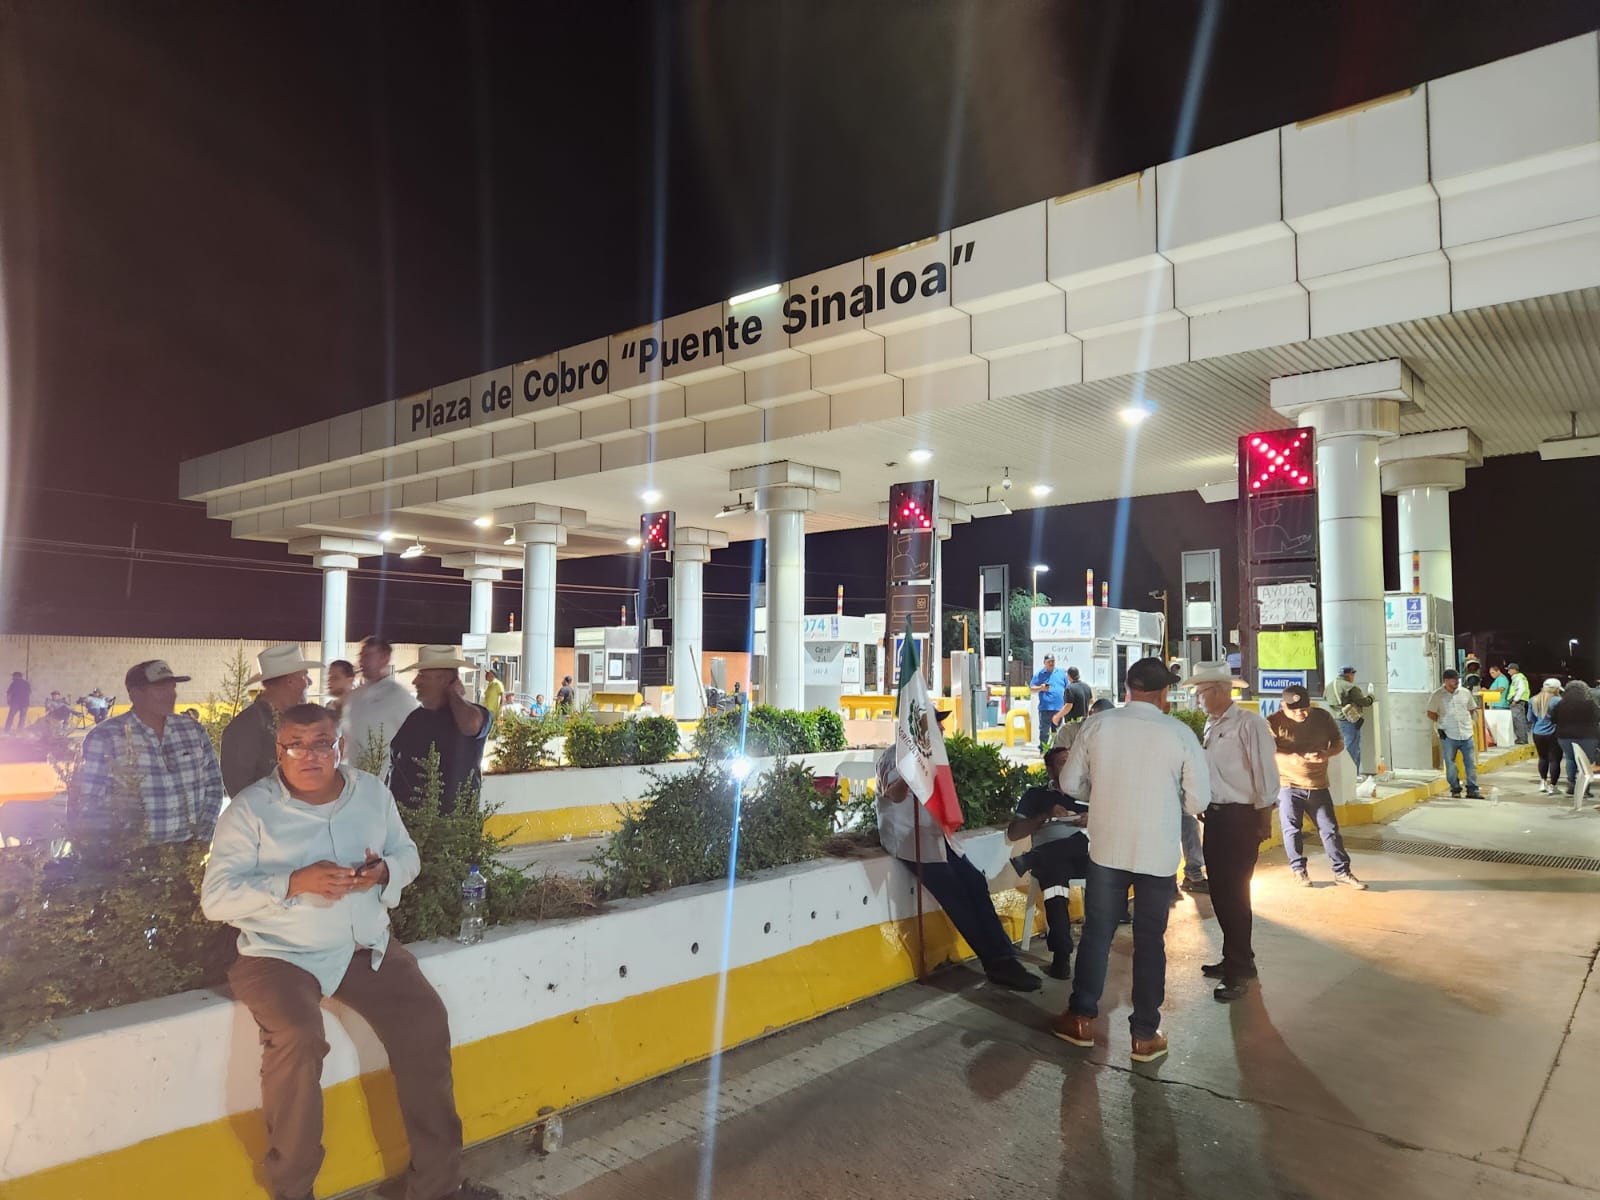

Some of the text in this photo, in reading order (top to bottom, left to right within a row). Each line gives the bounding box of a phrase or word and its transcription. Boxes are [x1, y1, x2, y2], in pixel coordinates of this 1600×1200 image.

[411, 396, 471, 432] Plaza
[481, 380, 512, 413] de
[523, 358, 609, 402] Cobro
[1262, 585, 1306, 598] AYUDA
[1038, 612, 1073, 628] 074
